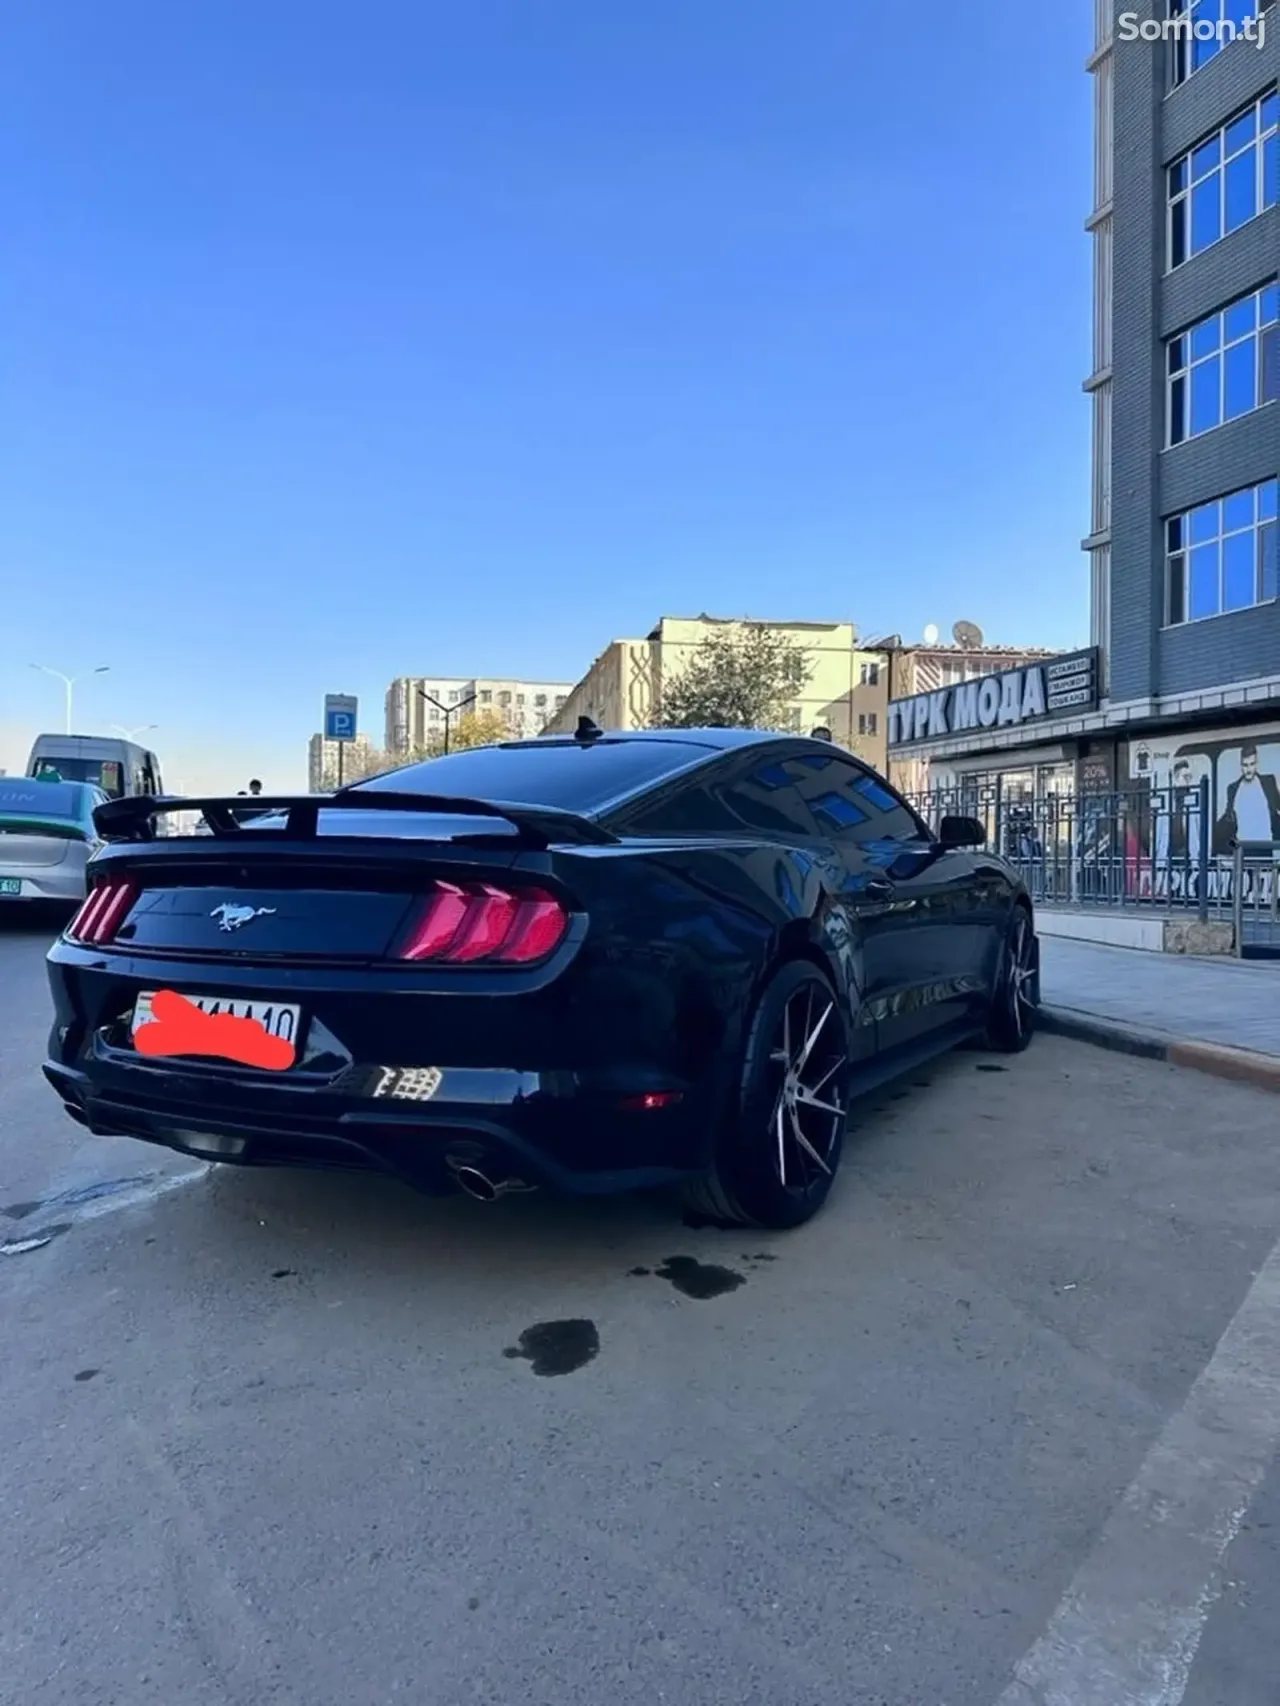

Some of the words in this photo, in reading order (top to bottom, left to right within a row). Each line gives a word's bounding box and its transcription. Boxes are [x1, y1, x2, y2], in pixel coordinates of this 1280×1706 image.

[335, 713, 350, 736] P
[888, 691, 949, 743] ТУРК
[953, 667, 1045, 727] МОДА
